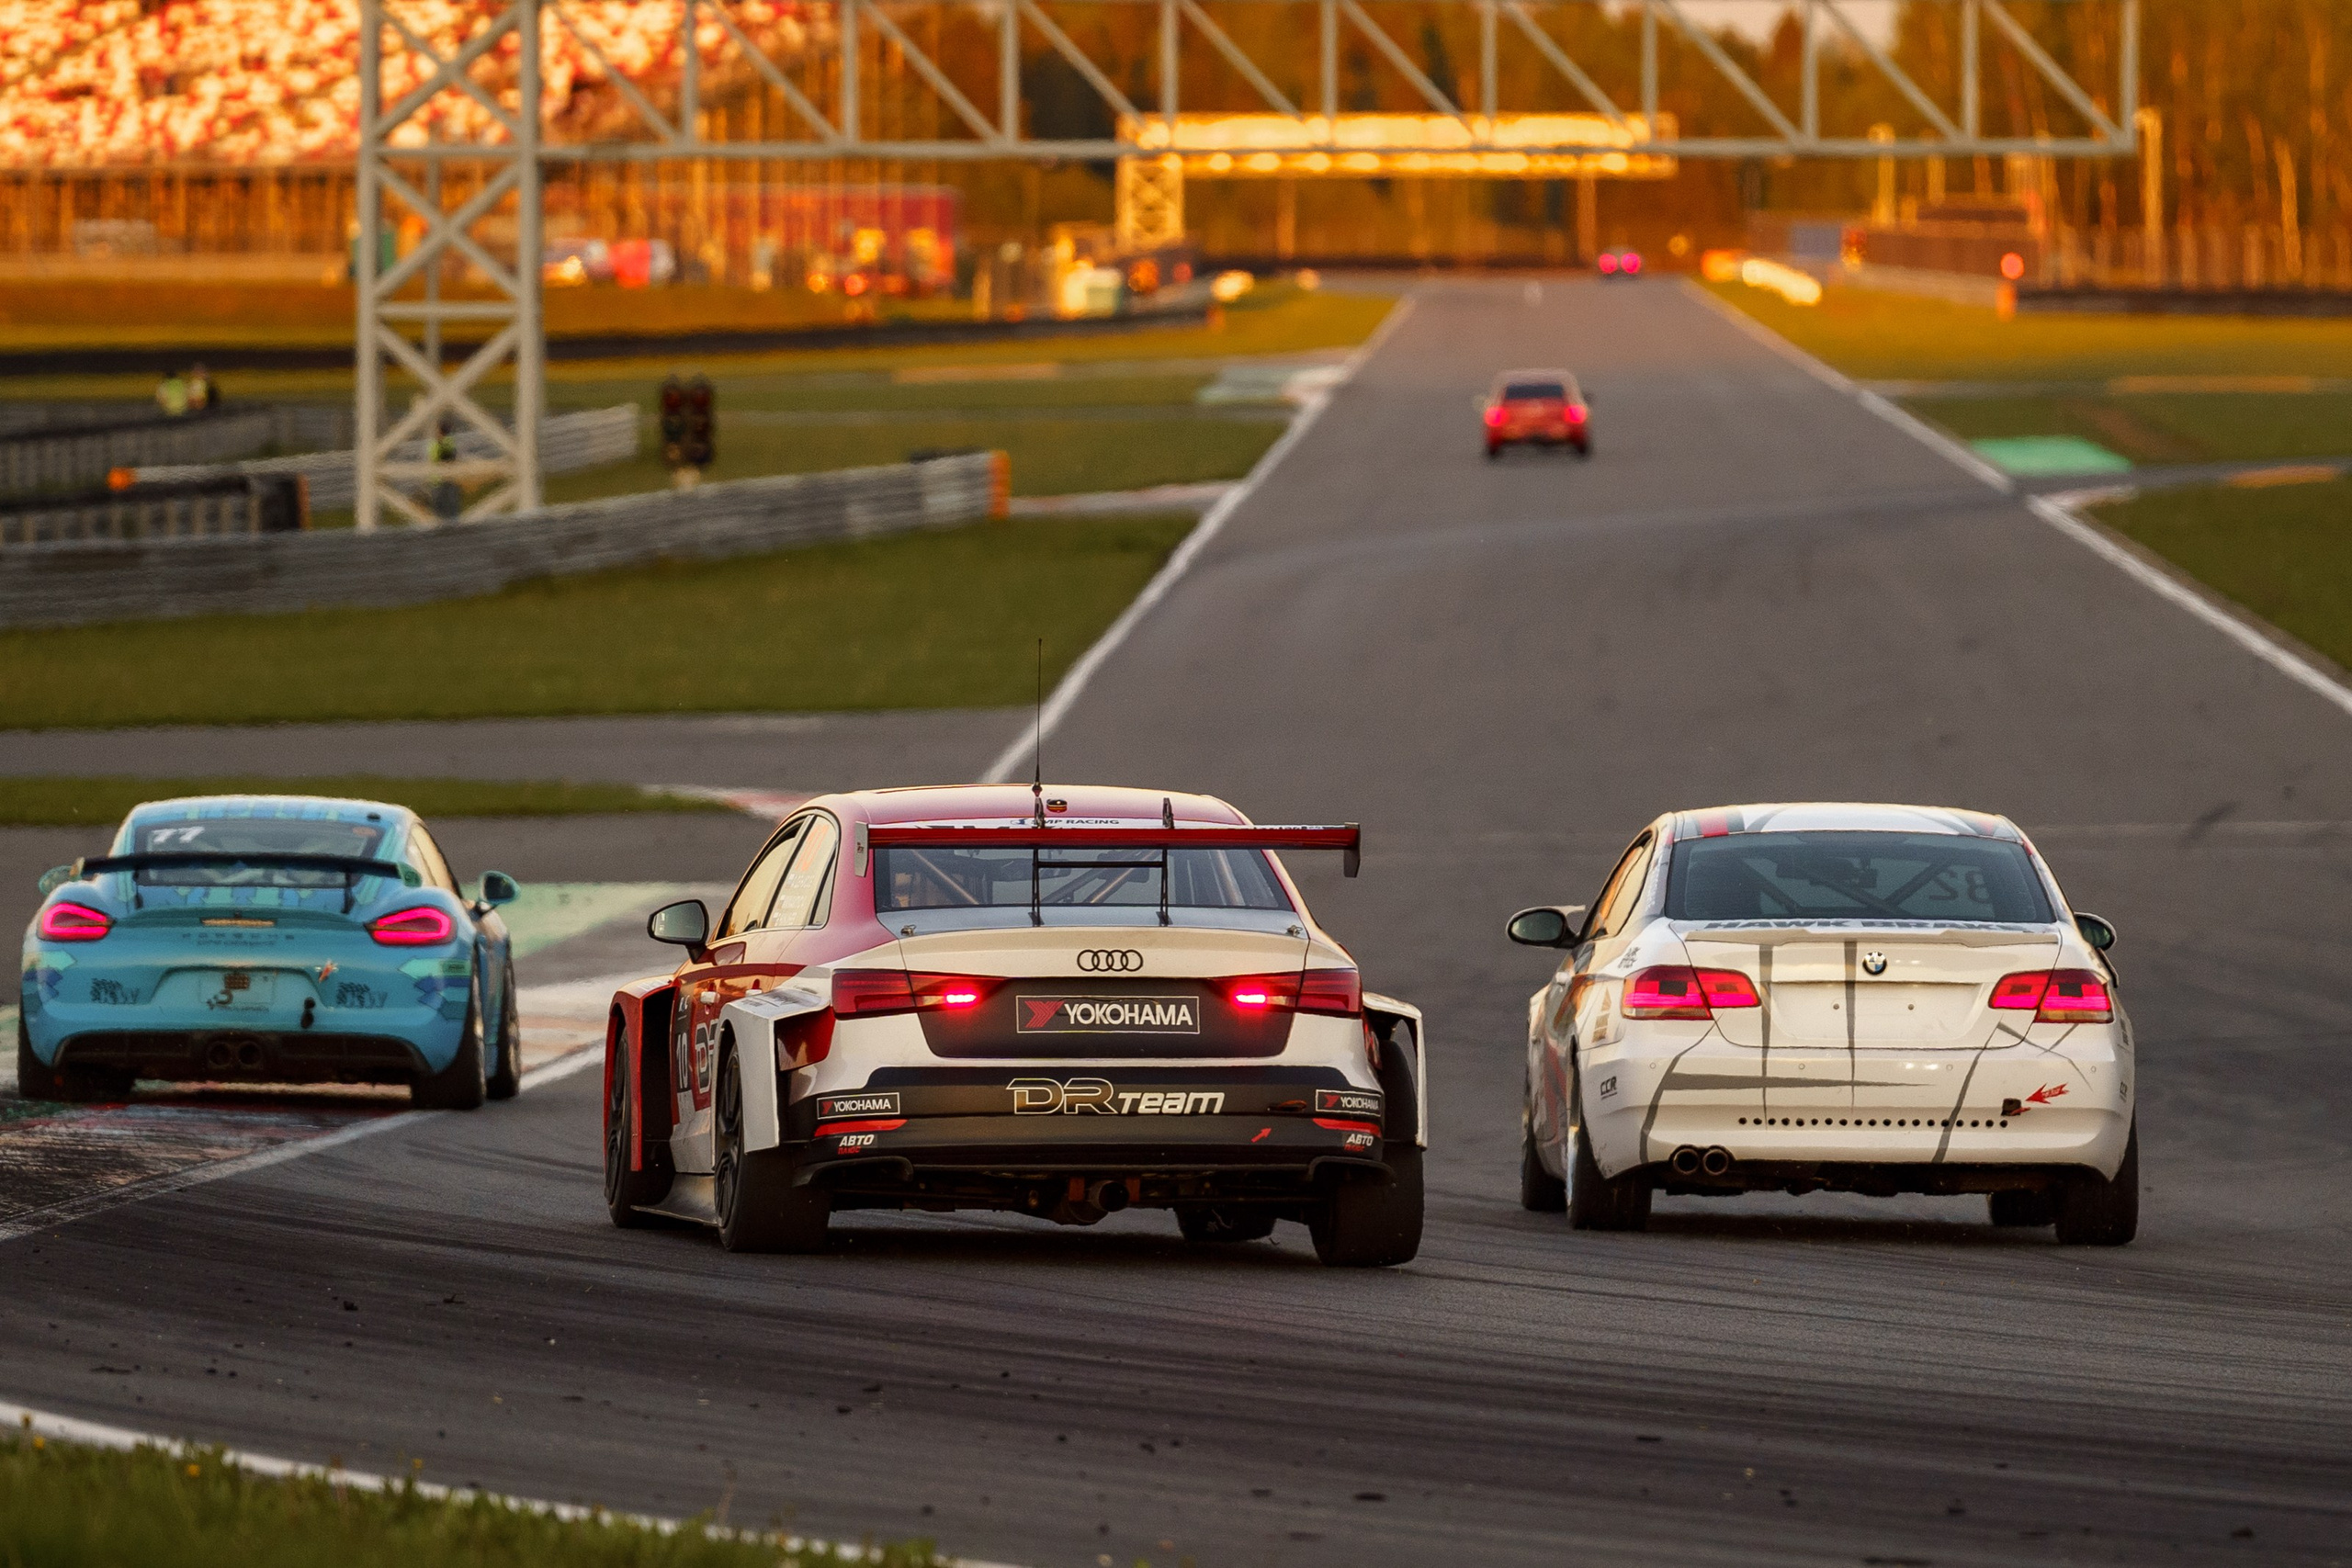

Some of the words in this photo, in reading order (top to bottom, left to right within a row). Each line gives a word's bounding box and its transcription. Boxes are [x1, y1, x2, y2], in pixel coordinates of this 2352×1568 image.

[152, 827, 205, 843] 77
[1703, 920, 1850, 930] HAWK
[1064, 1003, 1193, 1026] YOKOHAMA
[676, 1032, 688, 1089] 10
[1006, 1077, 1118, 1114] DR
[833, 1098, 892, 1112] YOKOHAMA
[839, 1134, 875, 1147] АВТО
